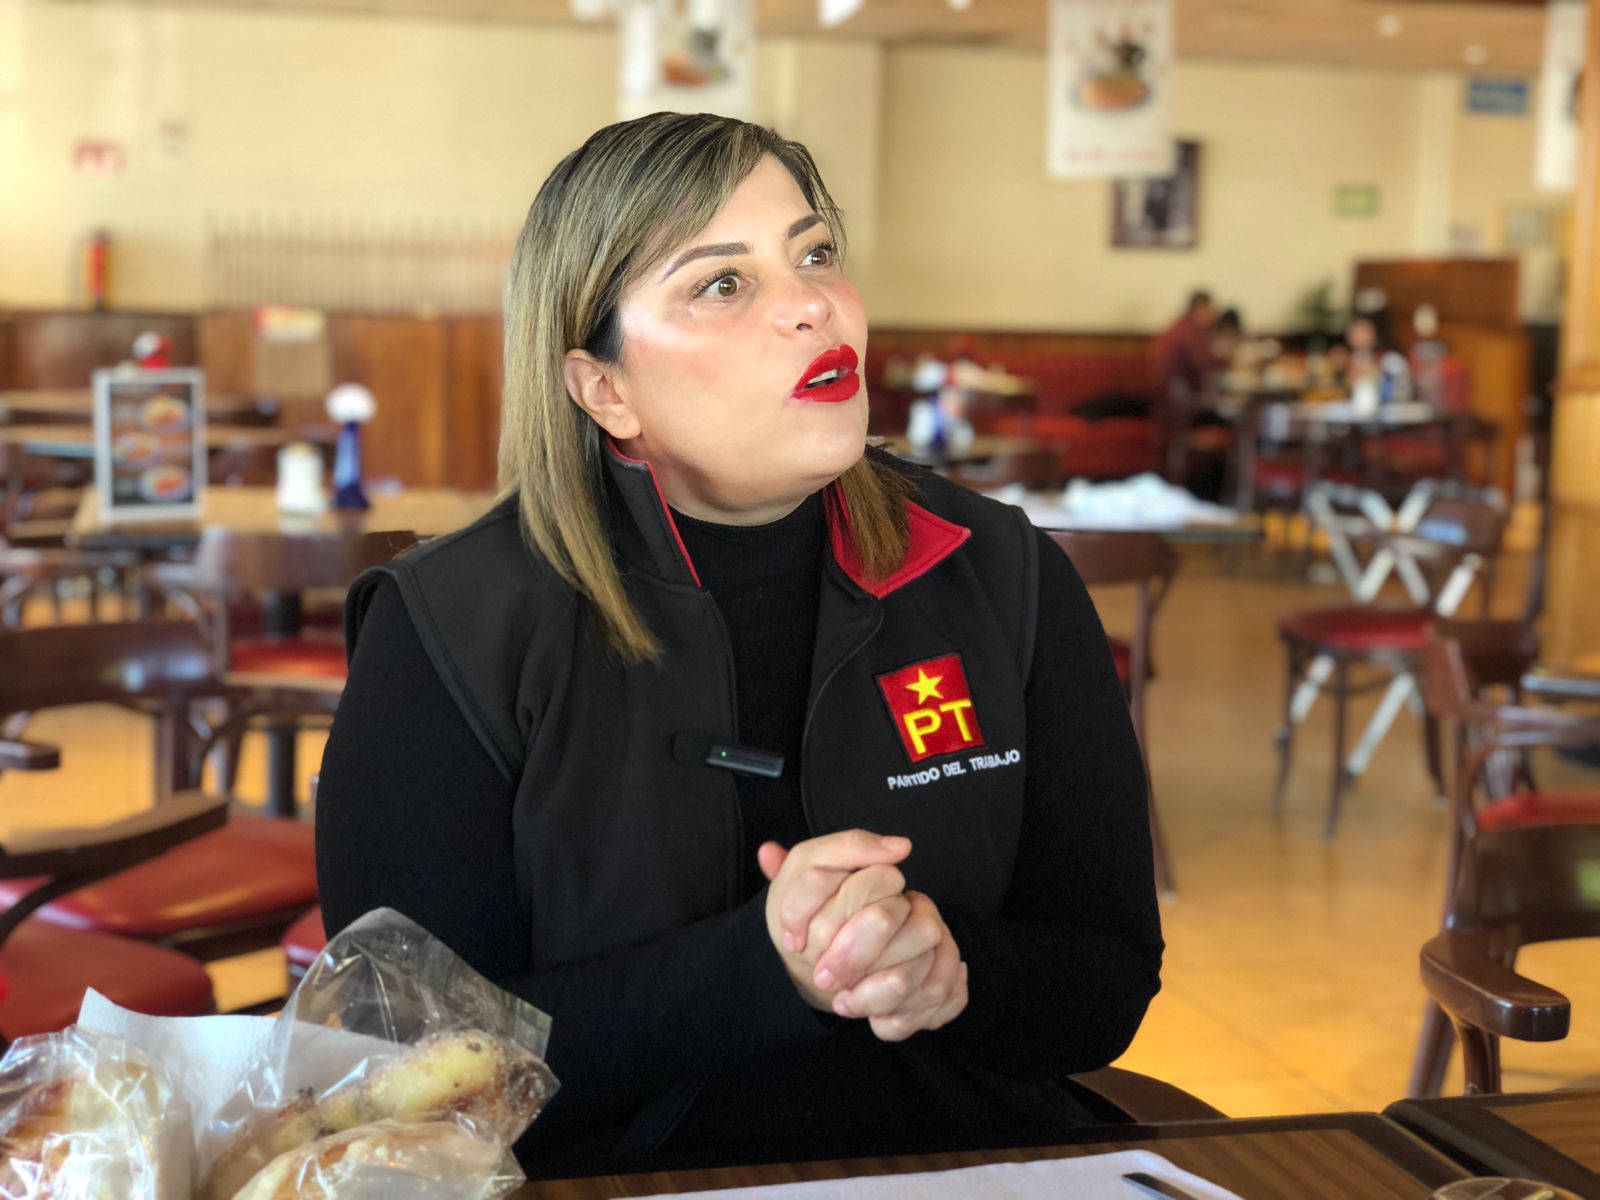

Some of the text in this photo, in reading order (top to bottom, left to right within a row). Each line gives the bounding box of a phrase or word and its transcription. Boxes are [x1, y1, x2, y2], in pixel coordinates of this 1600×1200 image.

[903, 699, 972, 755] PT
[887, 749, 1020, 790] PARTIDO DEL TRABAJO
